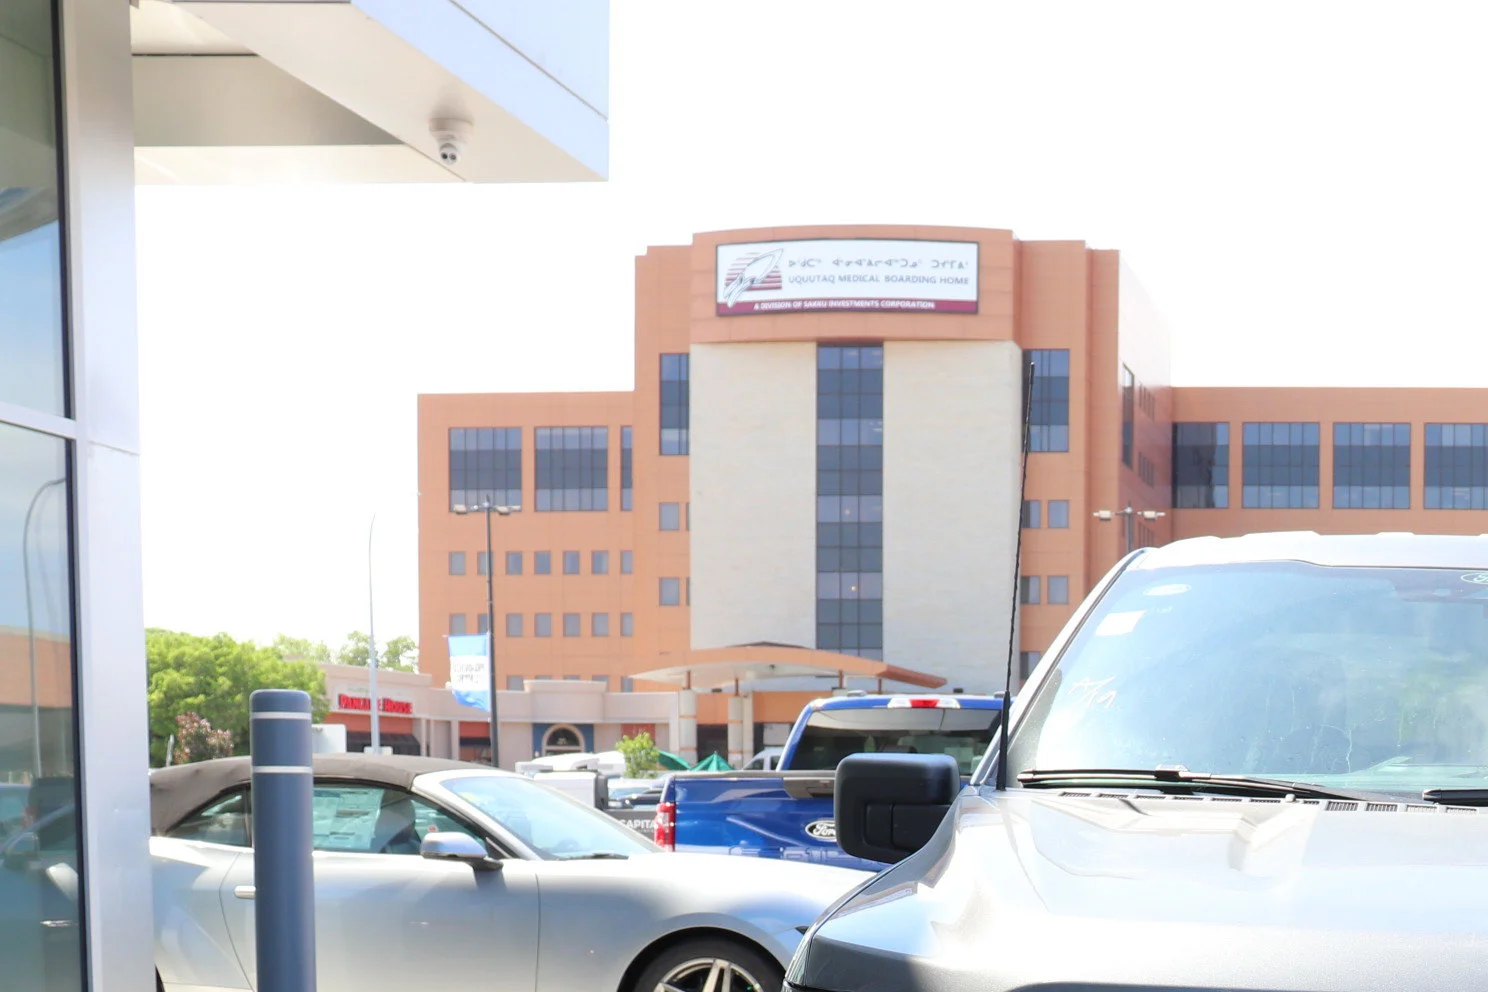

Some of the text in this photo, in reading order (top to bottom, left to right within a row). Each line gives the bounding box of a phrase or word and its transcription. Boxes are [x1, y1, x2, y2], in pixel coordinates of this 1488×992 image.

[788, 273, 970, 285] UQUUTAQ MEDICAL BOARDING HOME
[828, 300, 879, 308] INVESTMENTS
[880, 300, 936, 309] CORPORATION
[339, 693, 382, 711] PANCAE
